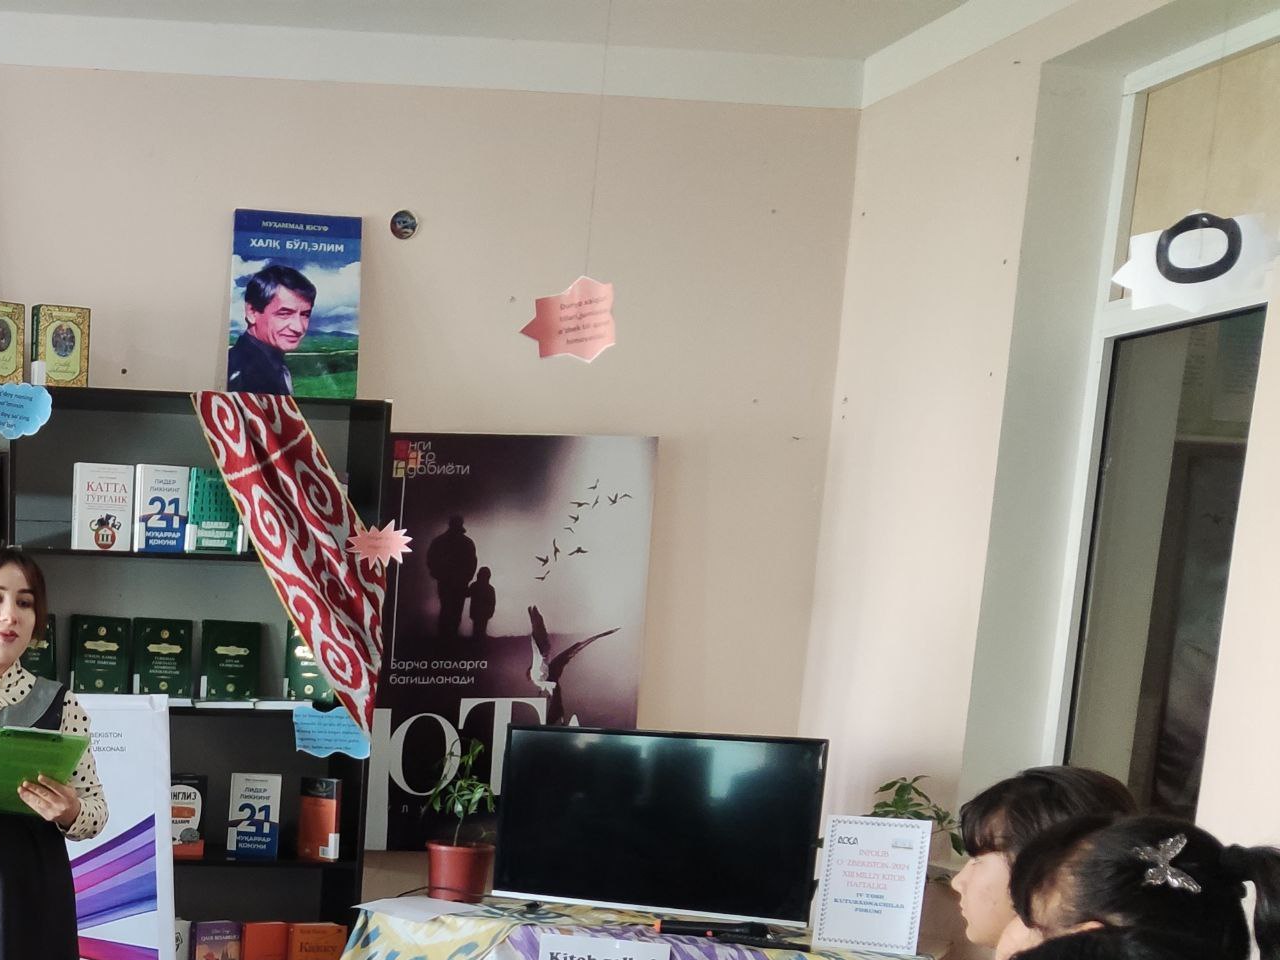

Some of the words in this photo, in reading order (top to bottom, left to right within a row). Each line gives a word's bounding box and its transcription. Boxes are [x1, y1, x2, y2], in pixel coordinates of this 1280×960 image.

[250, 239, 280, 250] ХАЛҚ
[86, 481, 128, 494] КАТТА
[148, 495, 181, 529] 21
[390, 658, 428, 673] Барча
[431, 659, 488, 671] оталарга
[170, 791, 197, 801] НГЛИЗ
[237, 803, 271, 834] 21
